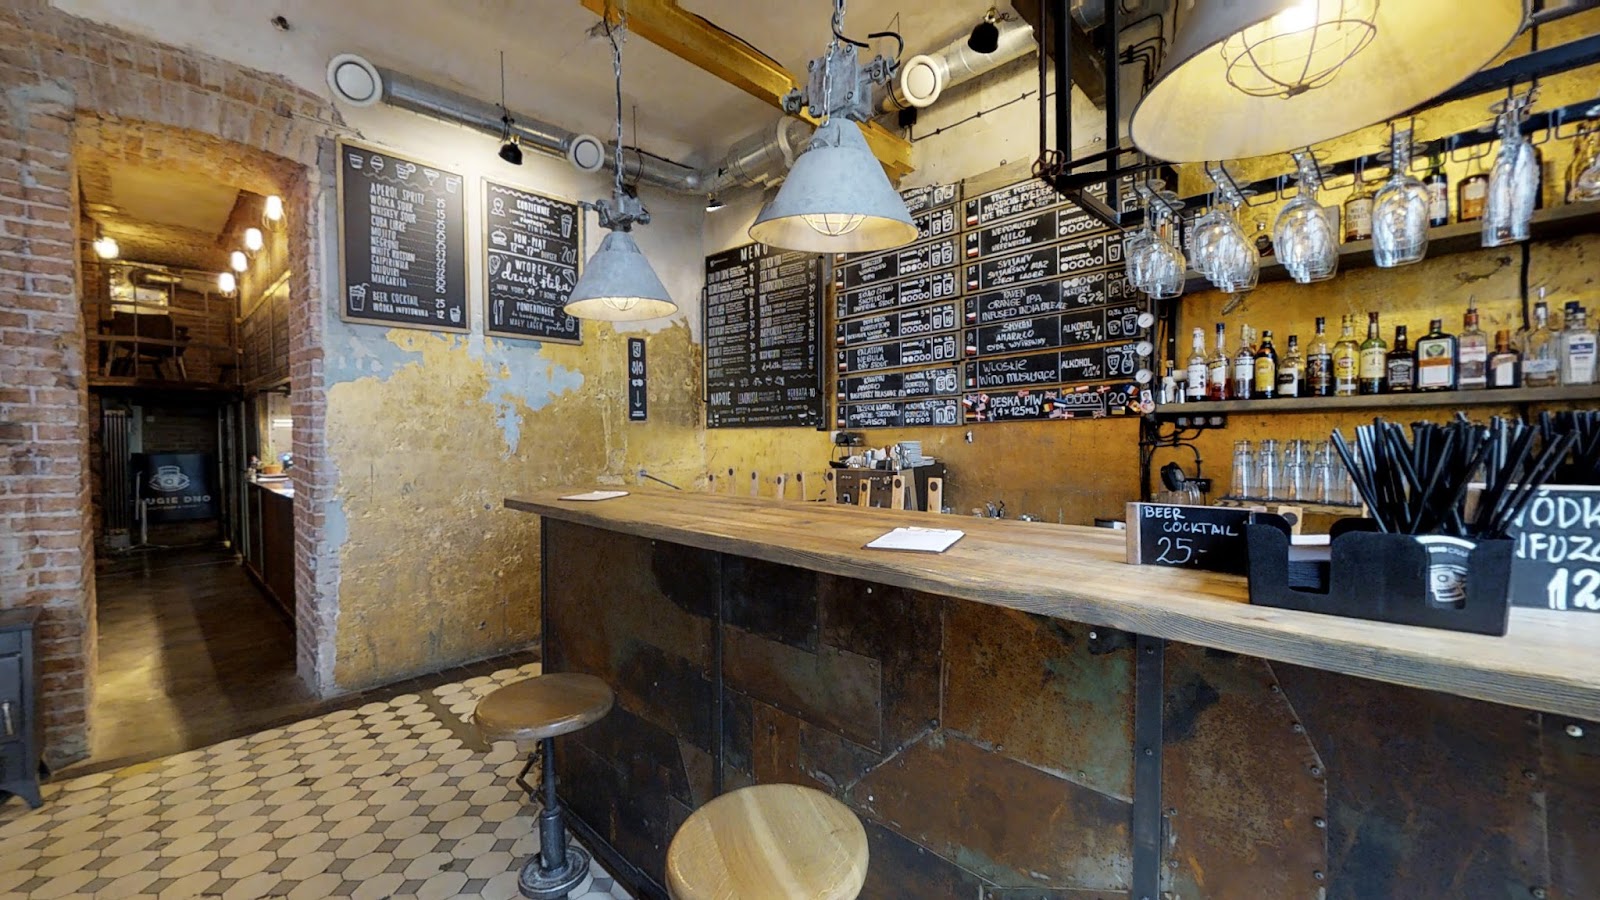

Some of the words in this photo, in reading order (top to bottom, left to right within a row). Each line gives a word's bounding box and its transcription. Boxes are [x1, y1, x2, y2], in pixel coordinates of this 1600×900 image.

[370, 182, 398, 200] APEROL
[402, 189, 425, 206] SPRITZ
[397, 200, 414, 213] SOUR
[370, 204, 399, 220] WHISKEY
[400, 211, 416, 225] SOUR
[1060, 215, 1090, 226] GORYCZKA
[371, 215, 388, 229] CUBA
[389, 219, 406, 233] LIBRE
[991, 219, 1039, 236] NEPOMUCEN
[371, 226, 397, 241] MOJITO
[1000, 230, 1026, 244] MILO
[371, 236, 400, 251] NEGRONI
[1060, 243, 1086, 252] ALKOHOL
[371, 246, 390, 258] WHITE
[740, 243, 769, 262] MENU
[1060, 252, 1091, 262] GORYCZKA
[371, 263, 400, 277] DAIQUIRI
[515, 259, 548, 275] WTOREK
[371, 273, 408, 288] MARGARITA
[1019, 270, 1044, 280] LAGER
[1002, 289, 1026, 299] RAVEN
[1063, 285, 1092, 297] ALKOHOL
[372, 291, 389, 303] BEER
[391, 292, 419, 307] COCKTAIL
[435, 298, 446, 309] 25
[987, 299, 1021, 310] ORANGE
[1026, 294, 1042, 304] IPA
[436, 310, 445, 319] 12
[981, 308, 1017, 321] INFUSED
[1019, 305, 1040, 315] INDIA
[526, 321, 543, 331] LAGER
[1062, 321, 1095, 333] ALKOHOL
[996, 330, 1034, 342] AMARILLO
[987, 343, 1006, 351] CYDR
[856, 354, 885, 364] NEBULA
[870, 359, 888, 369] STOUT
[1061, 358, 1093, 369] ALKOHOL
[991, 396, 1020, 408] DESKA
[1025, 394, 1043, 406] PIW
[860, 418, 887, 426] SAISON
[145, 497, 178, 505] UGIE
[184, 495, 211, 503] DNO
[1144, 506, 1185, 521] BEER
[1163, 521, 1239, 536] COCKTAIL
[1547, 567, 1600, 610] 12
